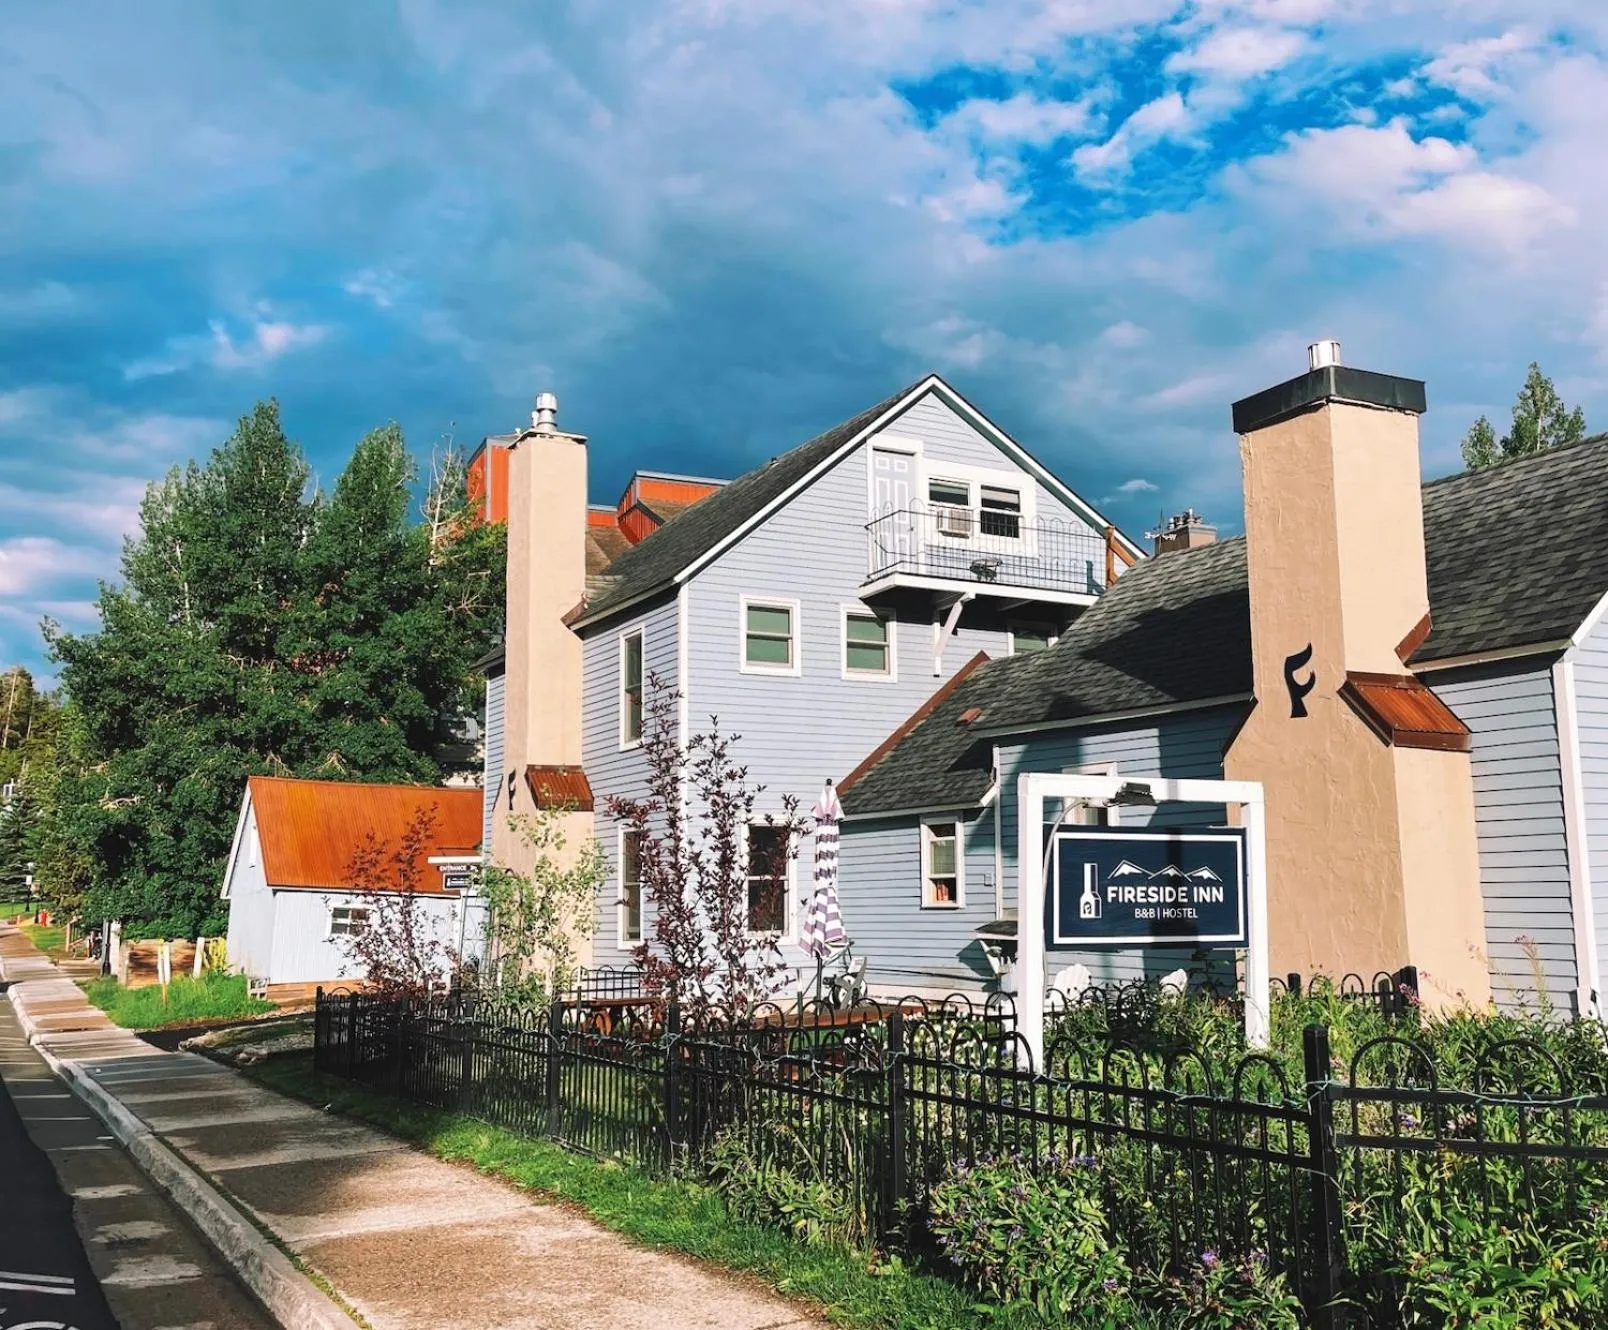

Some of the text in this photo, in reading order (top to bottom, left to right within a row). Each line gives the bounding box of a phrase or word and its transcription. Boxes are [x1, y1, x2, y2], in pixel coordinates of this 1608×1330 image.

[1107, 886, 1224, 903] FIRESIDE INN
[1134, 908, 1198, 919] B&B HOSTEL
